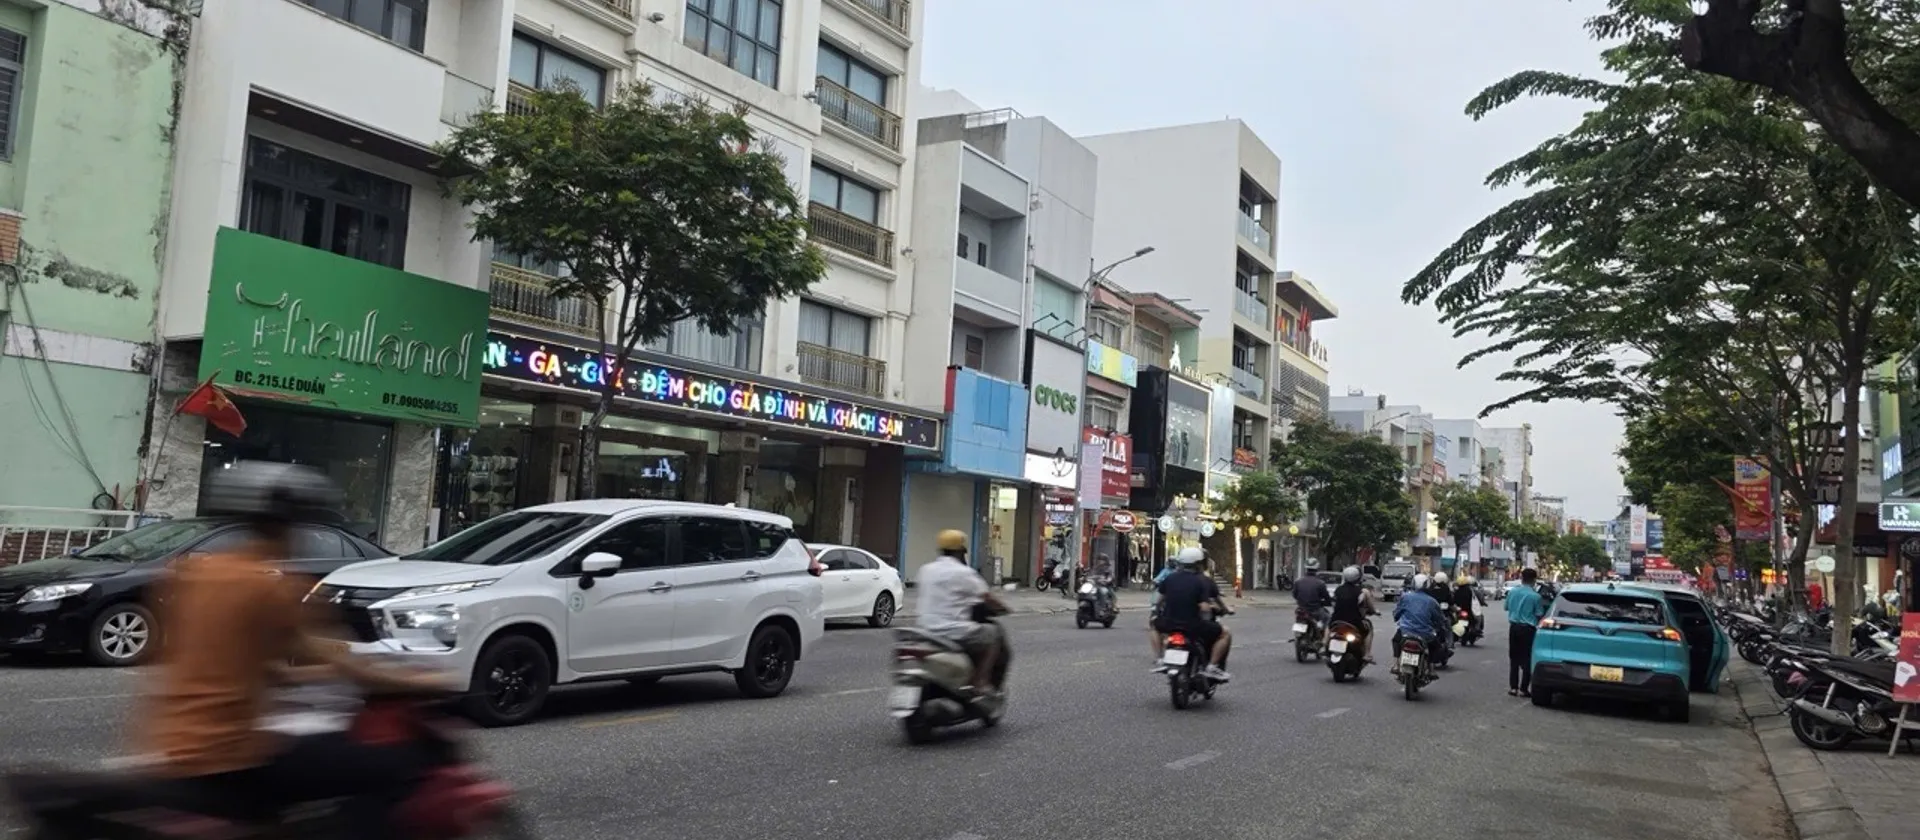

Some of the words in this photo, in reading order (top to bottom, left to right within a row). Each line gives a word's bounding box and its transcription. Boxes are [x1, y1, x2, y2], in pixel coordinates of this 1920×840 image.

[528, 350, 562, 378] GA
[642, 369, 684, 400] ĐỆM
[688, 380, 726, 406] CHO
[730, 389, 761, 413] GIA
[764, 392, 806, 420] ĐÌNH
[807, 400, 828, 423] VÀ
[831, 407, 876, 432] KHÁCH
[878, 416, 903, 439] SẠN
[1035, 384, 1077, 415] crocs
